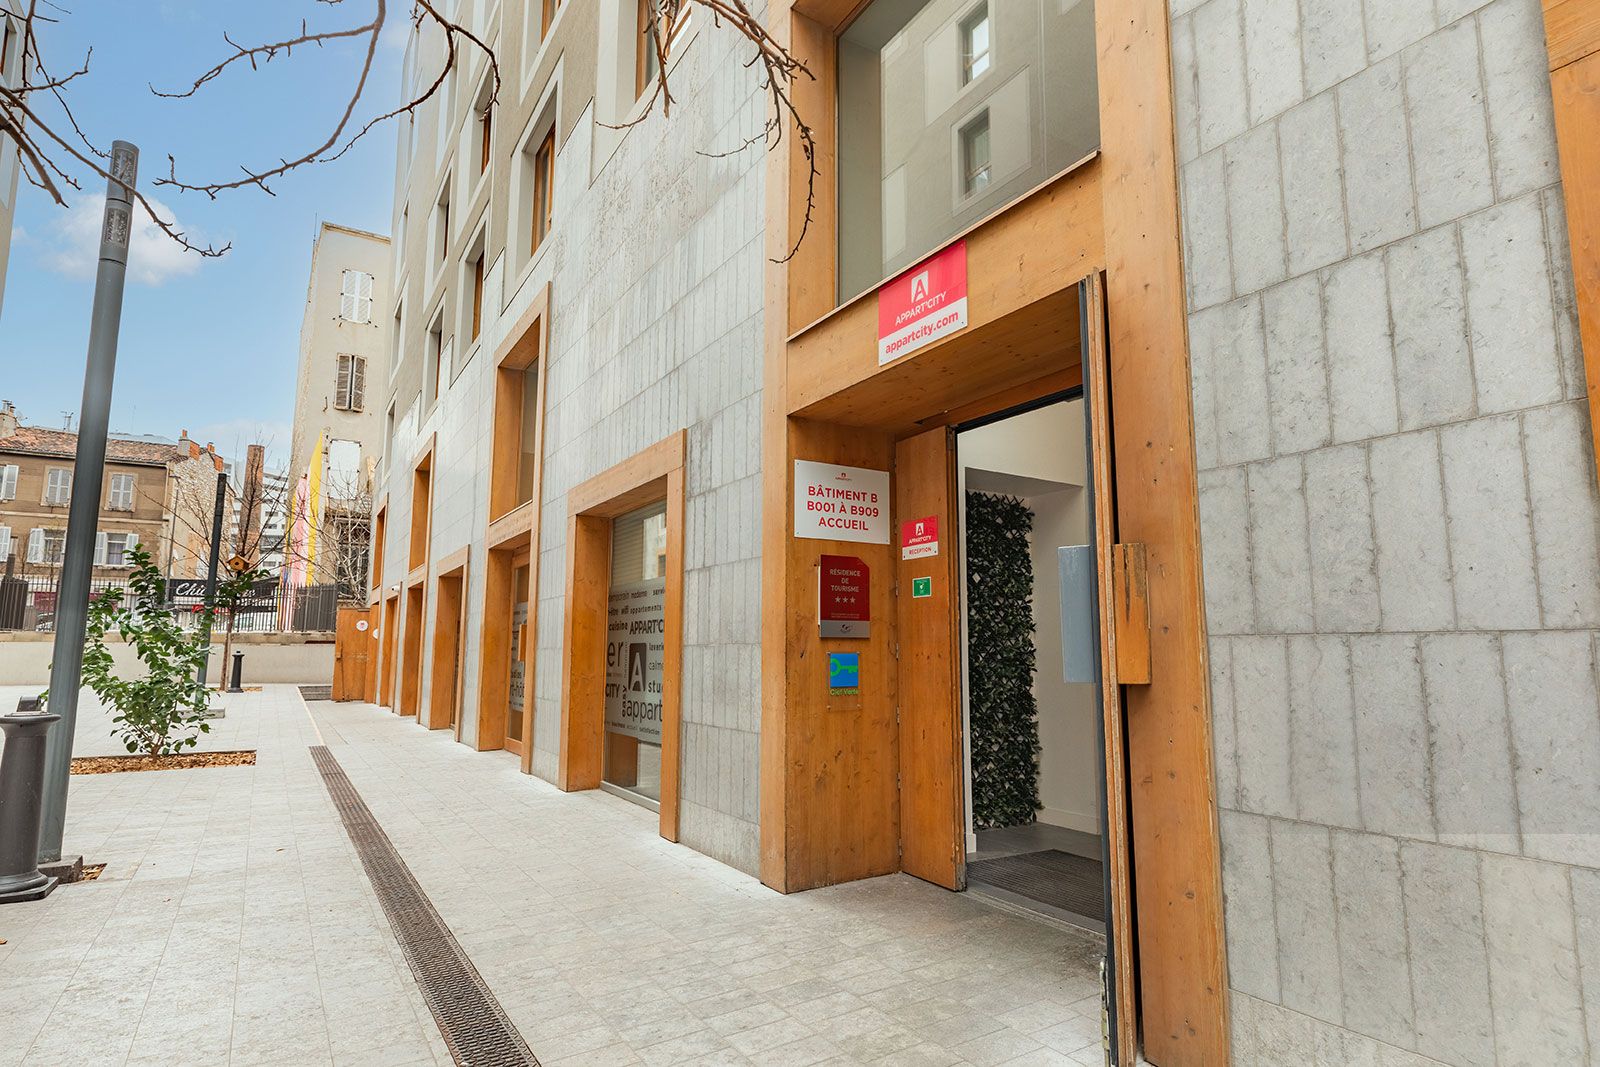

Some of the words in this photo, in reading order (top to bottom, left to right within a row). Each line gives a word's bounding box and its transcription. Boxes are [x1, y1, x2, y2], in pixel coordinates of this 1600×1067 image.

[895, 291, 947, 326] APPART'CITY
[885, 311, 959, 354] appartcity.com
[808, 484, 867, 502] BÂTIMENT
[870, 493, 878, 503] B
[807, 501, 836, 513] B001
[838, 502, 847, 514] À
[850, 507, 879, 517] B909
[818, 517, 869, 531] ACCUEIL
[831, 585, 859, 593] TOURISME
[630, 604, 661, 614] appartements
[609, 621, 628, 631] cuisine
